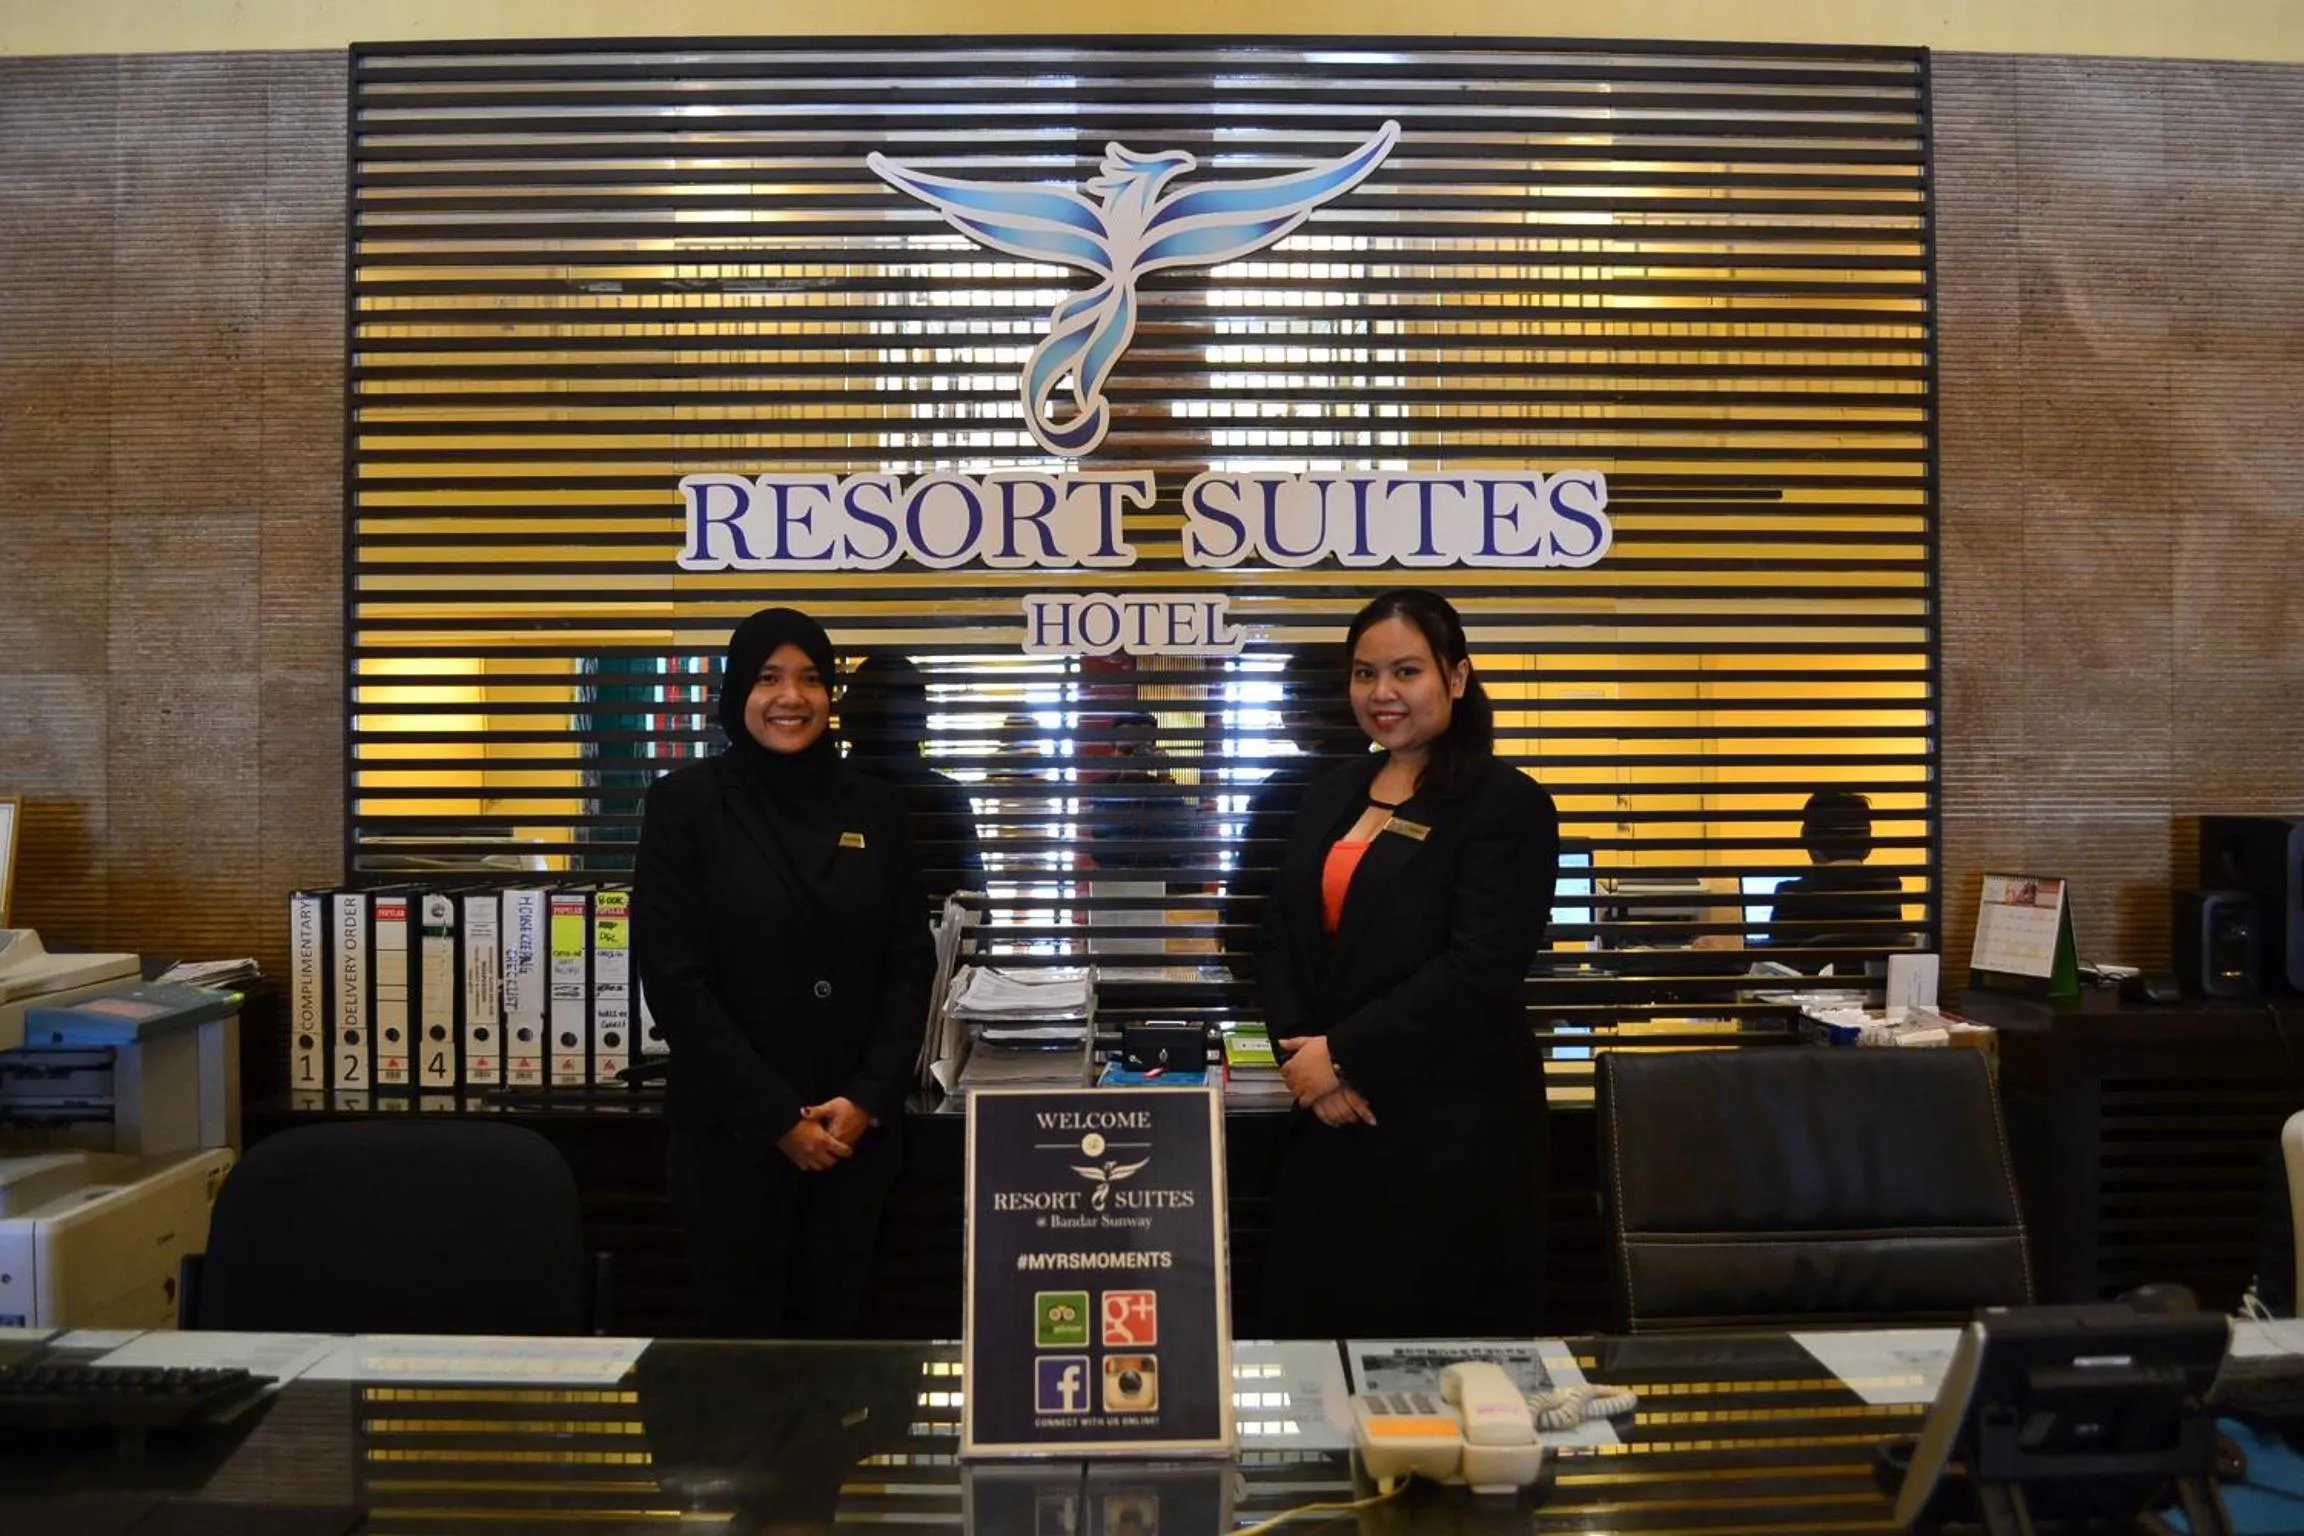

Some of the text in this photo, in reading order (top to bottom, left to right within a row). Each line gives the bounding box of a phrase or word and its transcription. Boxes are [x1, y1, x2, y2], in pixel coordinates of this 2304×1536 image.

[691, 477, 1604, 562] RESORT SUITES
[1031, 601, 1238, 648] HOTEL
[300, 894, 315, 1032] COMPLIMENTARY
[344, 897, 358, 1026] DELIVERY ORDER
[301, 1055, 315, 1082] 1
[344, 1054, 361, 1082] 2
[428, 1052, 447, 1079] 4
[1036, 1112, 1151, 1129] WELCOME
[993, 1190, 1195, 1211] RESORT SUITES
[1051, 1214, 1098, 1228] Bandar
[1102, 1213, 1152, 1231] Sunway
[1017, 1252, 1173, 1270] #MYRSMOMENTS
[1035, 1415, 1160, 1428] CONNECT WITH US ONLINE!
